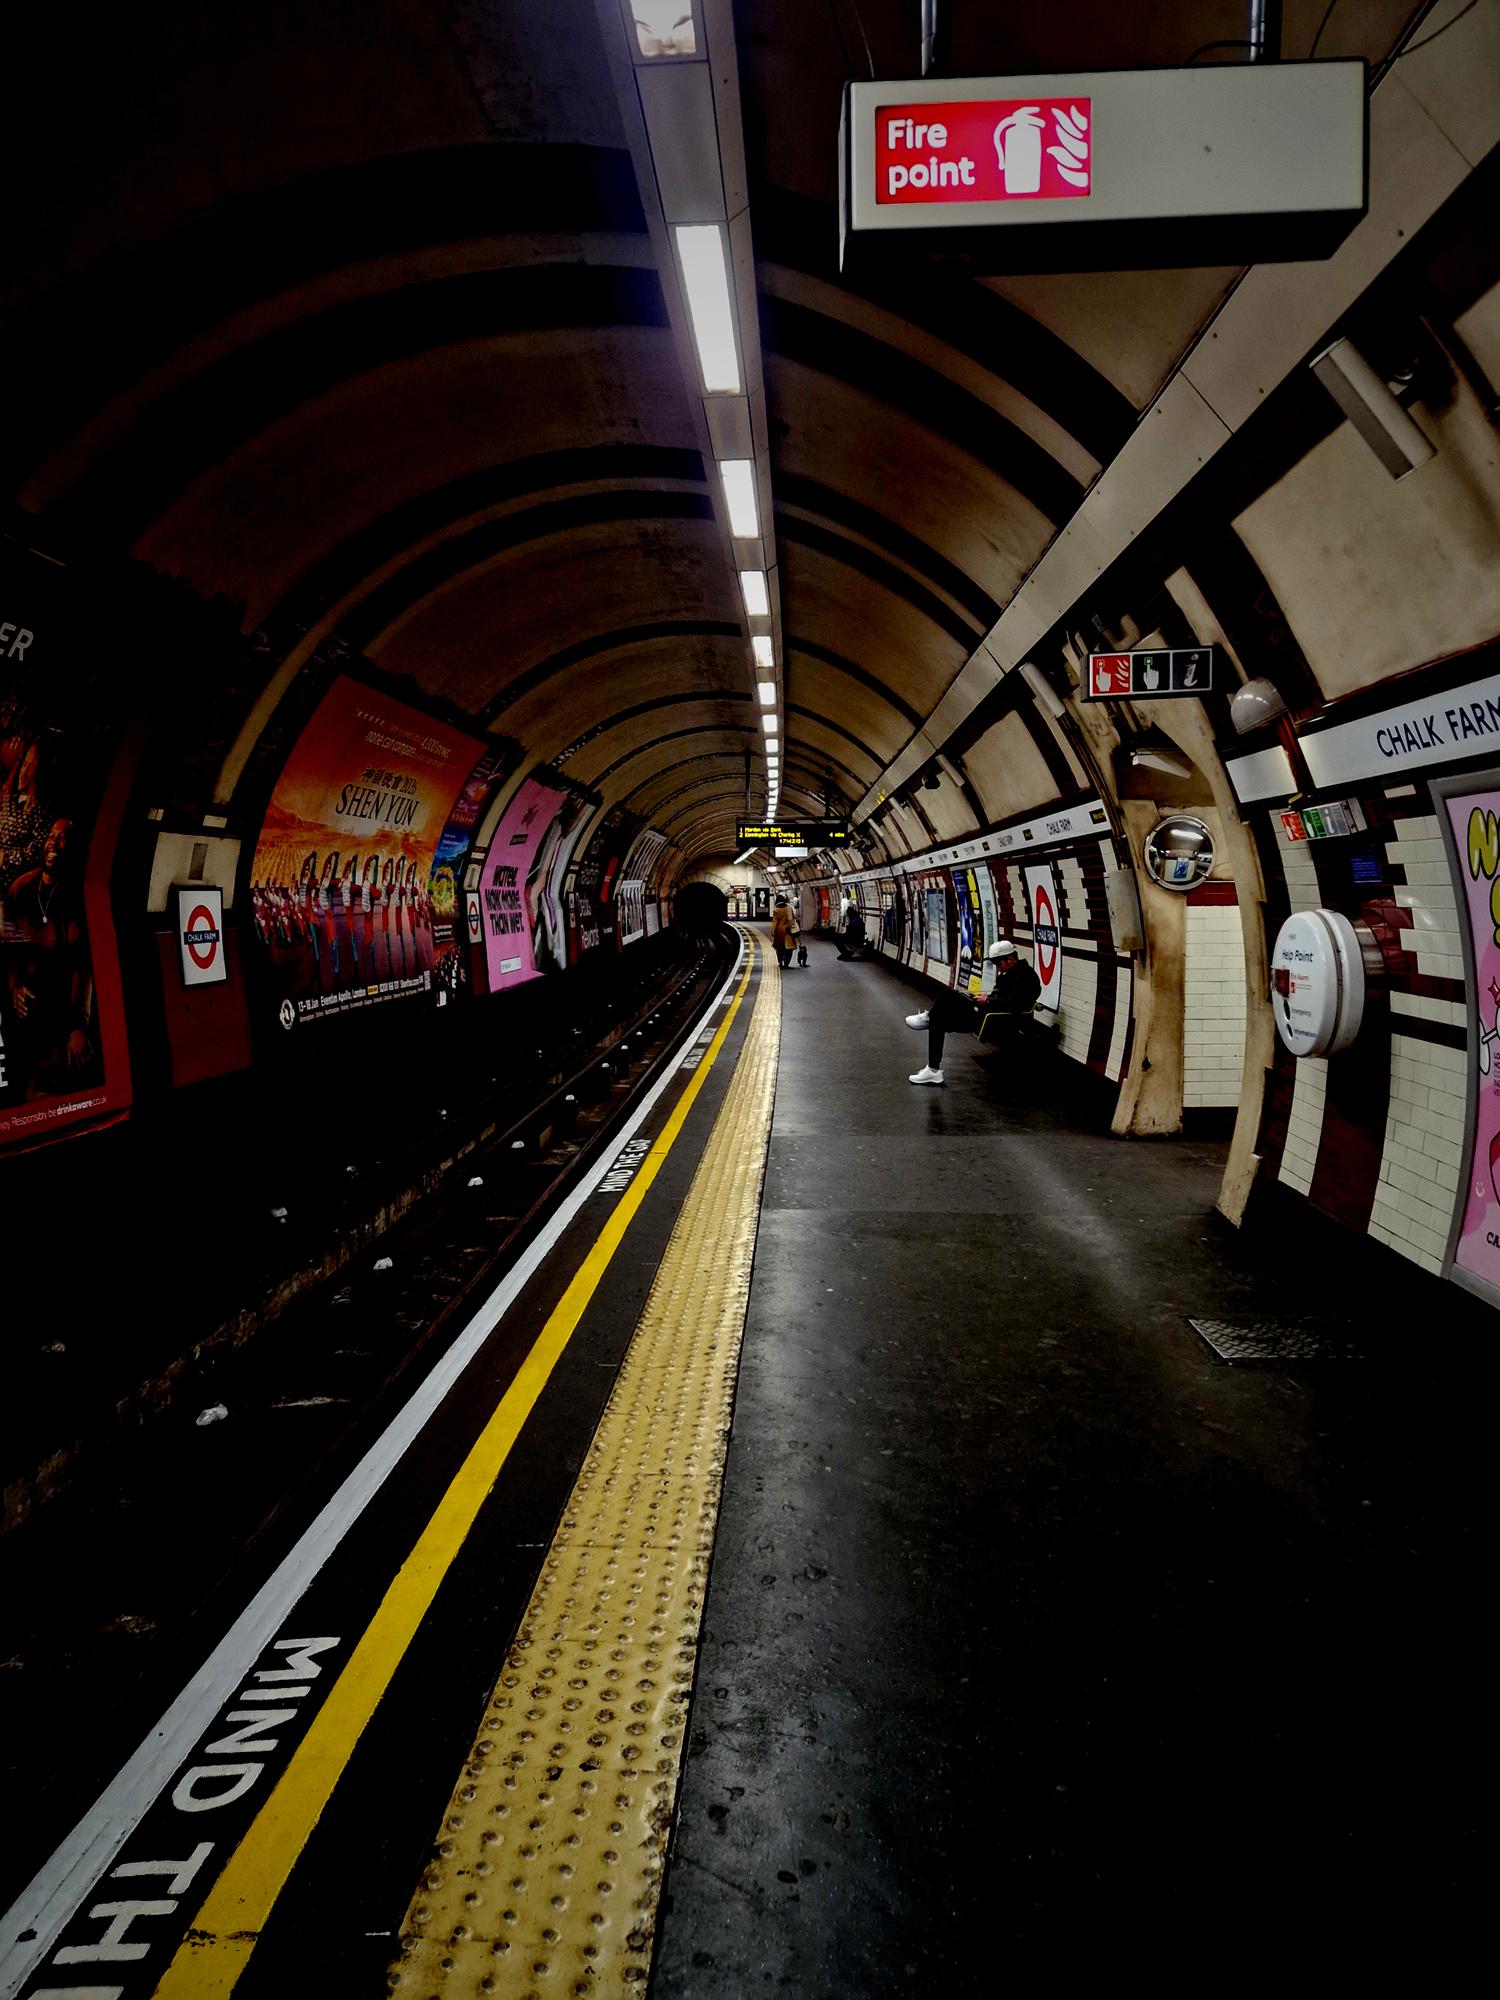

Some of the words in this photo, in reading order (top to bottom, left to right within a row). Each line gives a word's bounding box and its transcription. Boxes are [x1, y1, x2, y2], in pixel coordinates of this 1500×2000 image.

[888, 118, 948, 150] Fire
[888, 156, 976, 196] point
[1376, 715, 1445, 757] CHALK
[335, 783, 388, 819] SHEN
[384, 794, 420, 826] YUN
[1467, 806, 1500, 882] N
[187, 933, 203, 942] CHALK
[203, 932, 217, 941] FARM
[1036, 928, 1047, 941] CHALK
[1281, 949, 1293, 962] Help
[1294, 949, 1314, 963] Point
[612, 1152, 645, 1169] THE
[598, 1169, 634, 1192] MIND
[172, 1636, 342, 1813] MIND
[28, 1841, 216, 2000] TH
